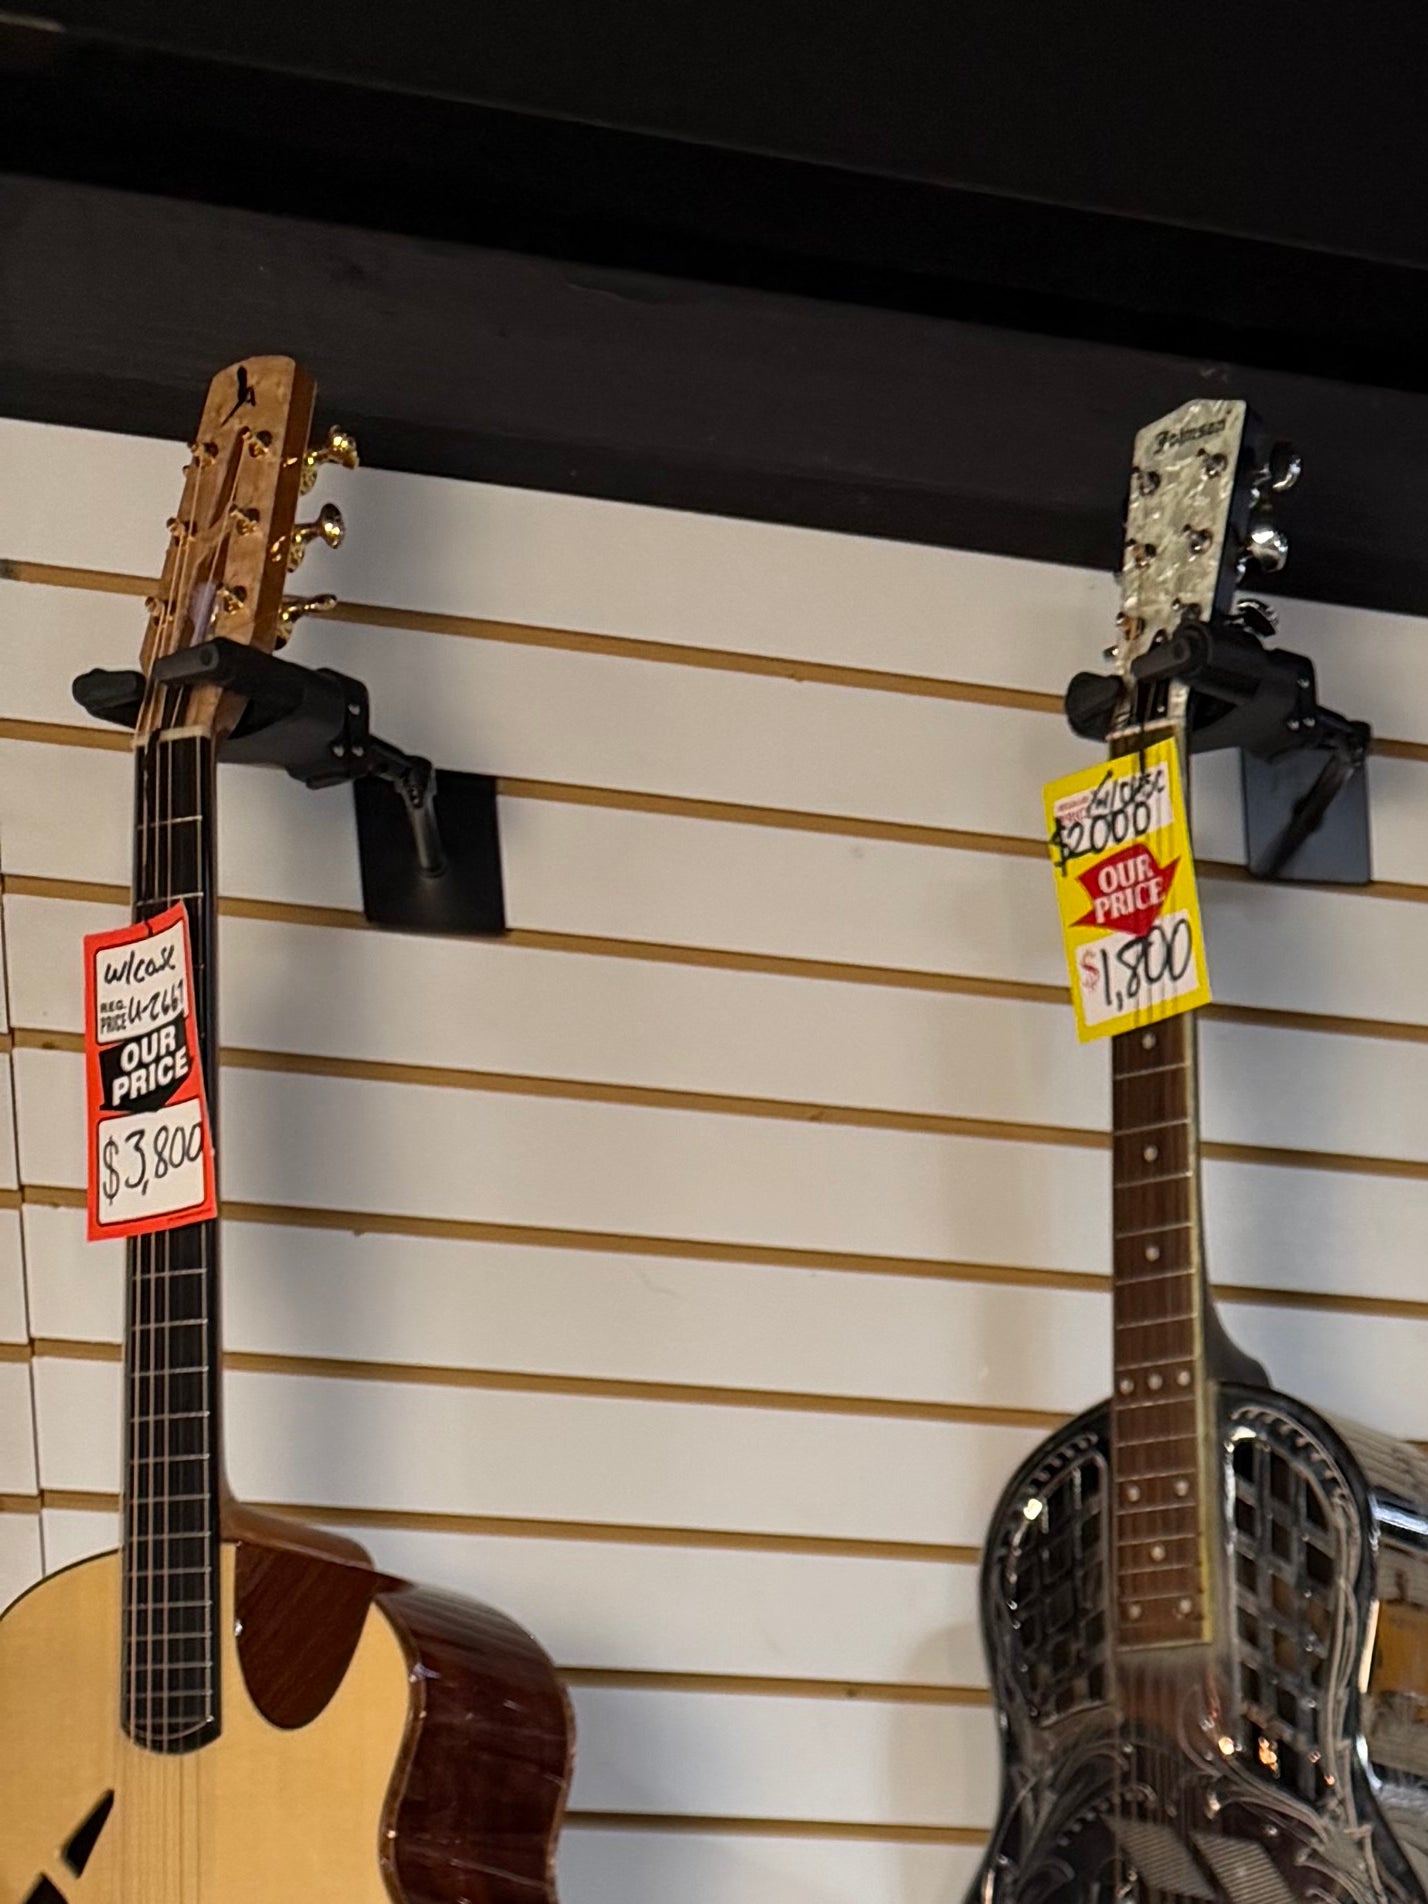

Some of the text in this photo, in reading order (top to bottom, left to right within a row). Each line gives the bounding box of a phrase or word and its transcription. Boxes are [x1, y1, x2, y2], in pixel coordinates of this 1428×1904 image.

[1100, 855, 1153, 896] OUR
[1093, 879, 1165, 925] PRICE
[120, 1025, 177, 1073] OUR
[111, 1046, 189, 1108] PRICE
[102, 1122, 203, 1206] $3,800
